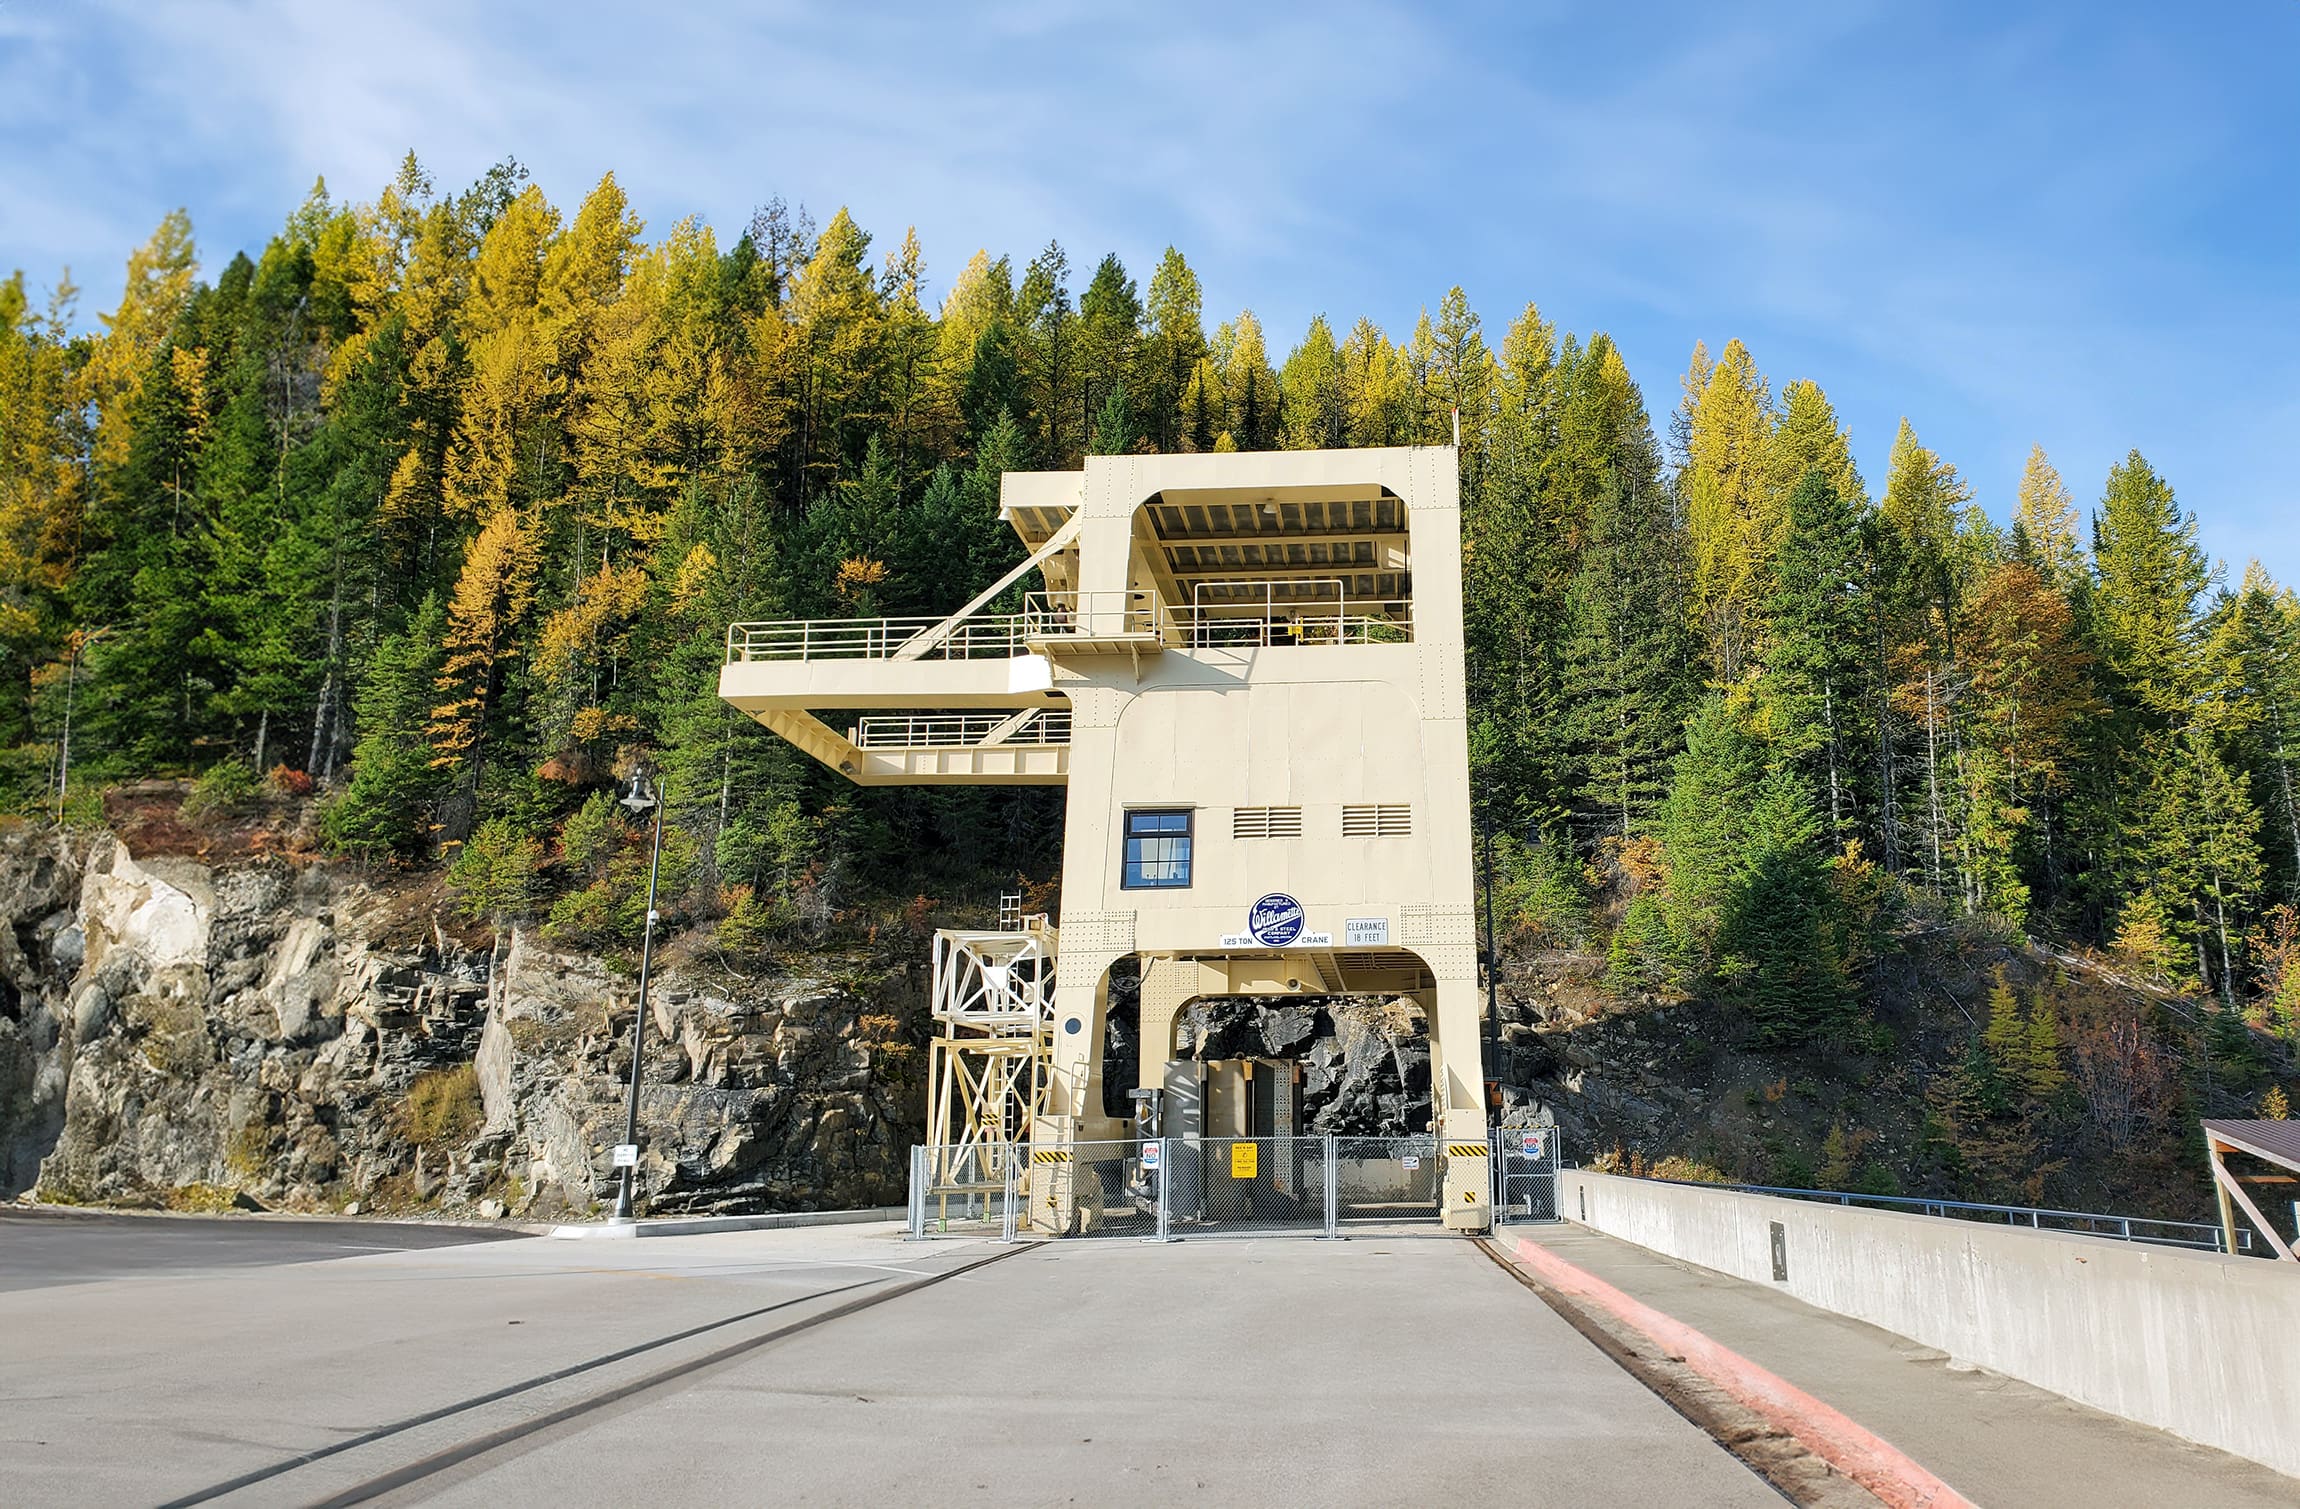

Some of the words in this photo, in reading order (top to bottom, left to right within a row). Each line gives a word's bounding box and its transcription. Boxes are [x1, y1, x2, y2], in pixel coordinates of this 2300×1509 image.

[1347, 922, 1386, 931] CLEARANCE
[1239, 937, 1253, 945] TON
[1301, 936, 1328, 944] CRANE
[1354, 933, 1361, 942] 18
[1364, 933, 1380, 942] FEET
